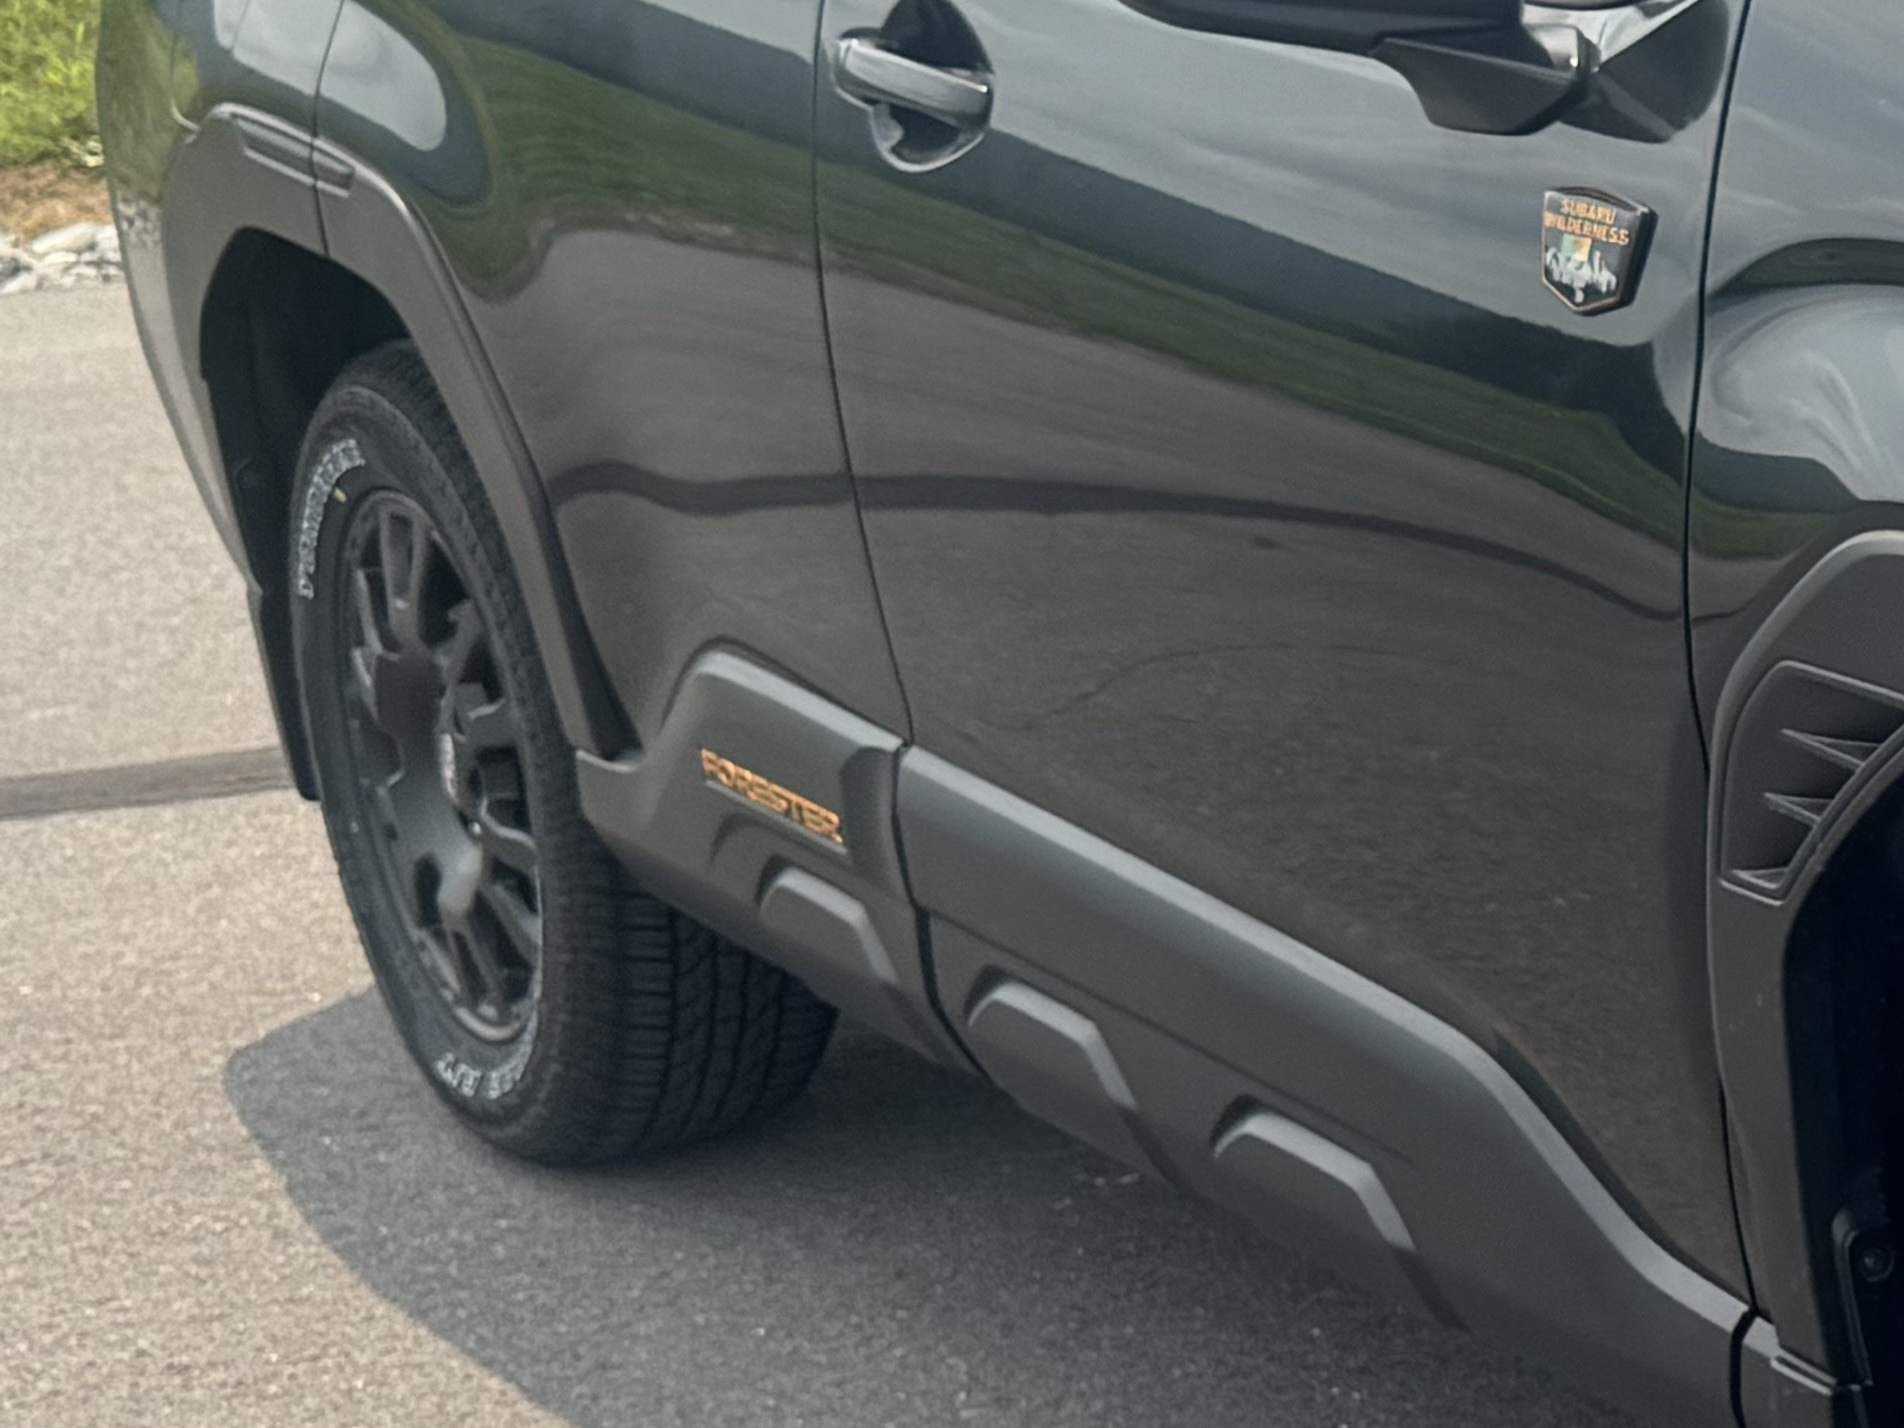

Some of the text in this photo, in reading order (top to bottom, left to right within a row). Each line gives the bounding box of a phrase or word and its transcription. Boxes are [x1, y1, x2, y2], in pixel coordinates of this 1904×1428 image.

[1544, 210, 1630, 245] WILDERNESS
[1561, 200, 1617, 224] SUBARU
[701, 748, 844, 844] FORESTER
